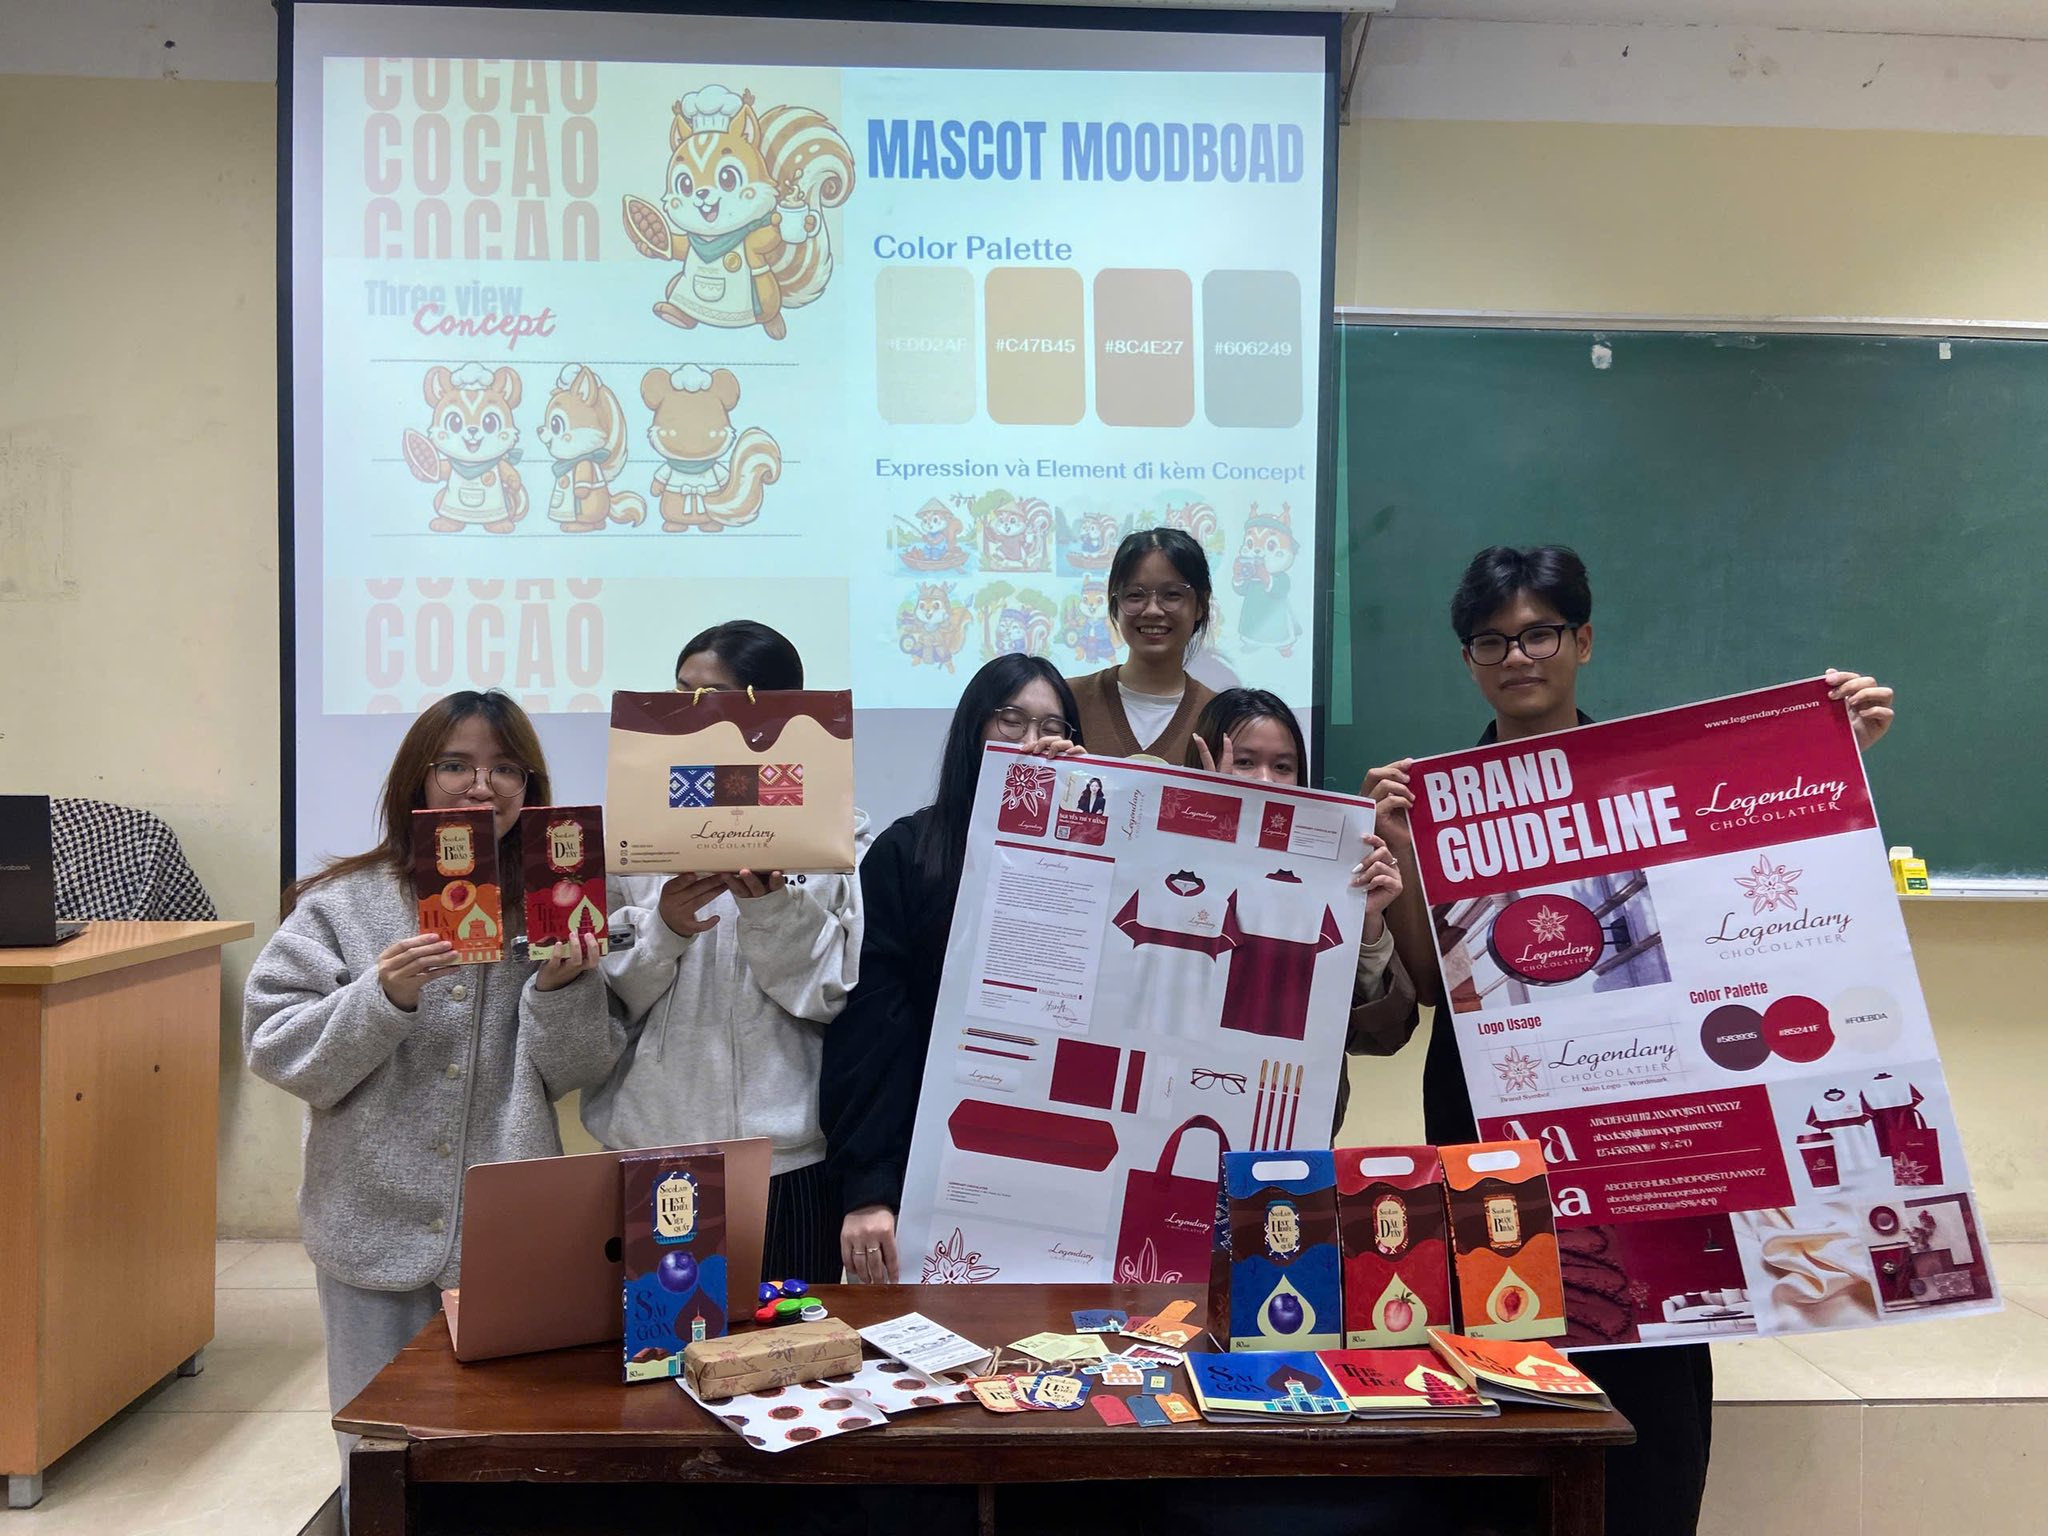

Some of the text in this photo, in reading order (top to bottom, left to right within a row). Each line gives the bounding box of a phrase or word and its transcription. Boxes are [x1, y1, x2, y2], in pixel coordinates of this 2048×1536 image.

[364, 113, 599, 198] COCAO
[867, 119, 1304, 183] MASCOT MOODBOAD
[874, 235, 1072, 260] Color Palette
[364, 280, 522, 315] Three view
[413, 302, 556, 349] Concept
[995, 338, 1076, 353] #C47B45
[1104, 339, 1184, 355] #8C4E27
[1214, 340, 1292, 357] #606249
[876, 458, 1305, 484] Expression và Element đi kèm Concept
[365, 602, 604, 688] COCAO
[1704, 700, 1820, 729] www.legendary.com.vn
[1424, 749, 1573, 822] BRAND
[1695, 776, 1848, 816] Legendary
[1710, 801, 1841, 831] CHOCOLATIER
[691, 820, 775, 843] Legendary
[1436, 785, 1688, 883] GUIDELINE
[696, 842, 770, 850] CHOCOLATIER
[1705, 908, 1852, 945] Legendary
[1514, 942, 1595, 964] Legendary
[1719, 933, 1847, 961] CHOCOLATIER
[1522, 955, 1591, 972] CHOCOLATIER
[1689, 982, 1769, 1004] Color Palette
[1478, 1016, 1542, 1035] Logo Usage
[1548, 1038, 1678, 1072] Legendary
[1560, 1062, 1672, 1084] CHOCOLATIER
[1581, 1085, 1600, 1093] Main
[1601, 1083, 1621, 1092] Logo
[1629, 1076, 1668, 1087] Wordmark
[1165, 1212, 1211, 1232] Legendary
[1048, 1243, 1094, 1263] Legendary
